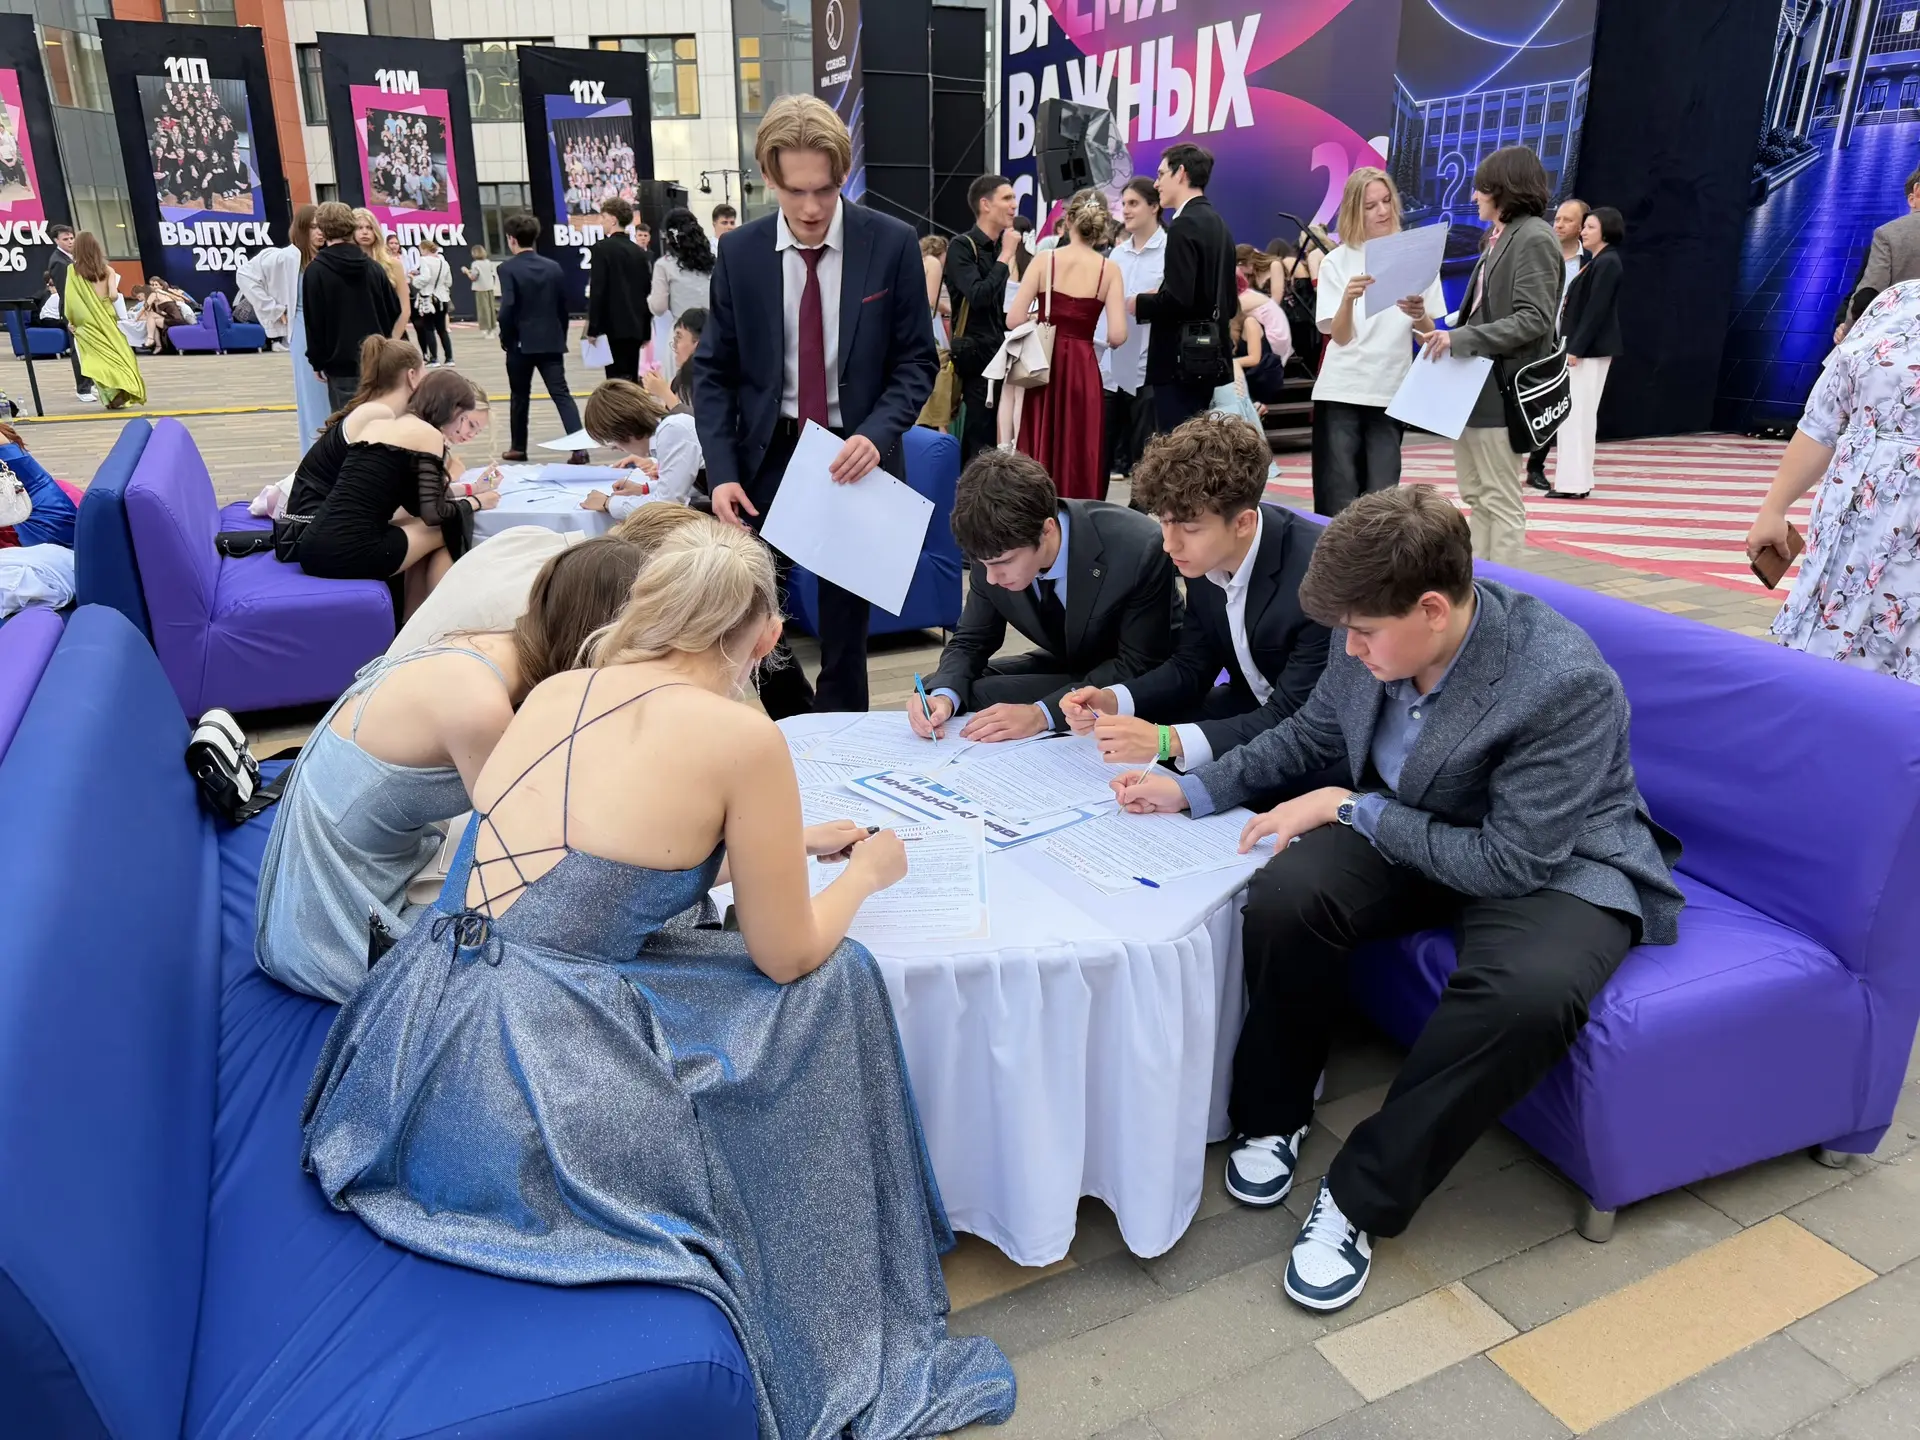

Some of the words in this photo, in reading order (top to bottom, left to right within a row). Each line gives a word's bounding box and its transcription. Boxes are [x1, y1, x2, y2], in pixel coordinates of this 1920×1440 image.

[164, 56, 211, 84] 11П
[374, 68, 421, 95] 11М
[569, 79, 607, 105] 11Х
[158, 221, 274, 246] ВЫПУСК
[380, 222, 468, 246] ЫПУСК
[195, 246, 250, 271] 2026
[1532, 396, 1569, 430] adidas
